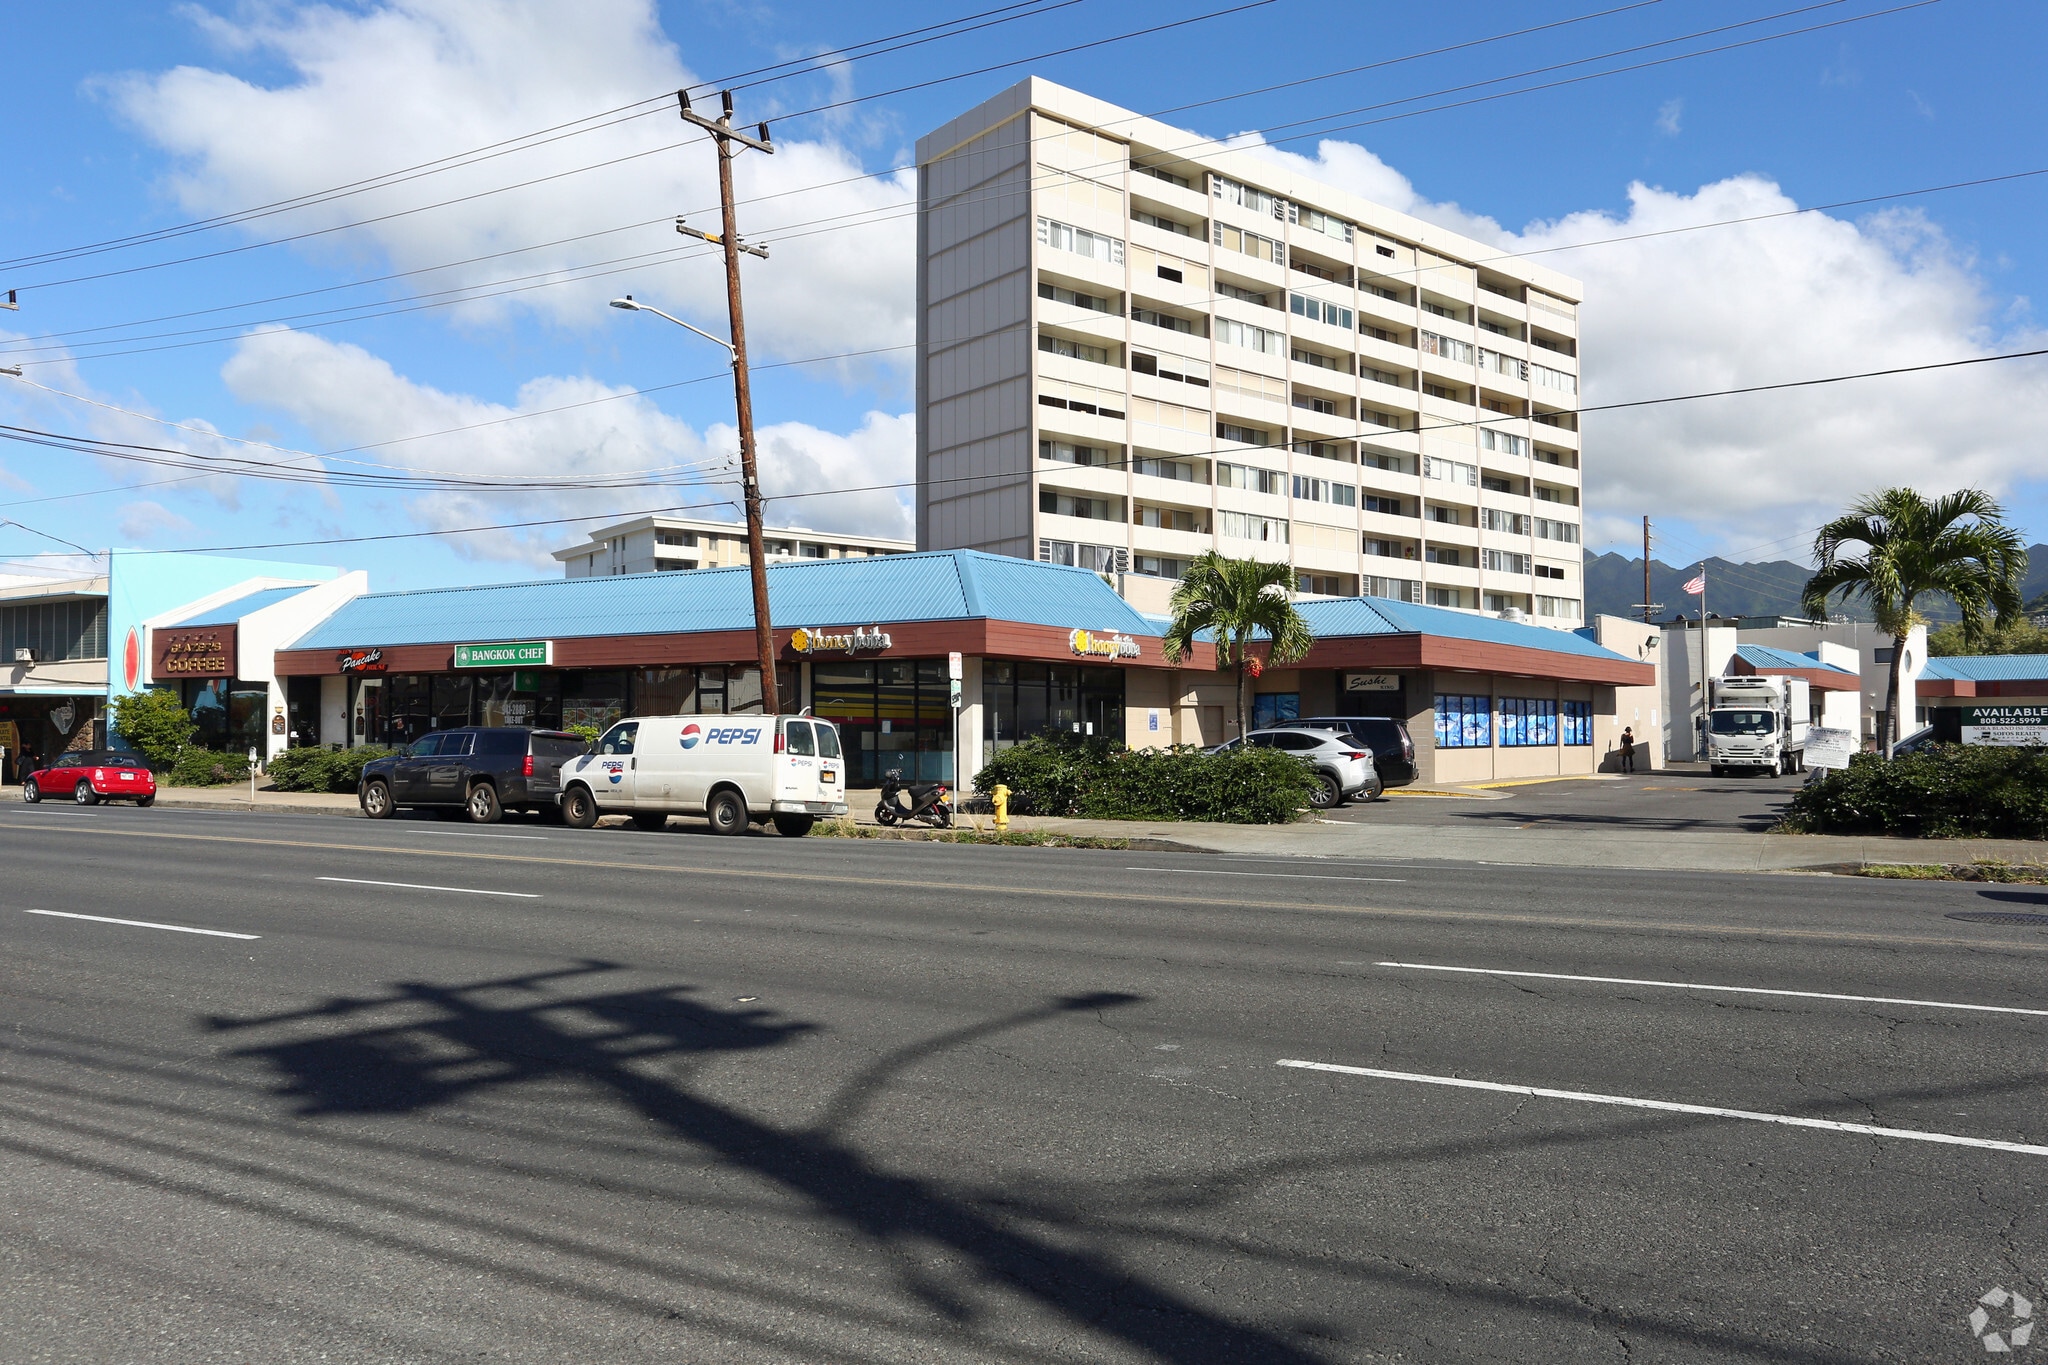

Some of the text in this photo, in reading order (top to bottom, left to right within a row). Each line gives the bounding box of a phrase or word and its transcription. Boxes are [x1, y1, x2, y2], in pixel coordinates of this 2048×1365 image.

[341, 649, 381, 672] Pancake
[472, 647, 544, 661] BANGKOK CHEF
[167, 656, 225, 672] COFFEE
[1350, 676, 1387, 689] Sushi
[1973, 708, 2048, 717] AVAILABLE
[705, 728, 761, 744] PEPSI
[601, 761, 624, 769] PEPSI
